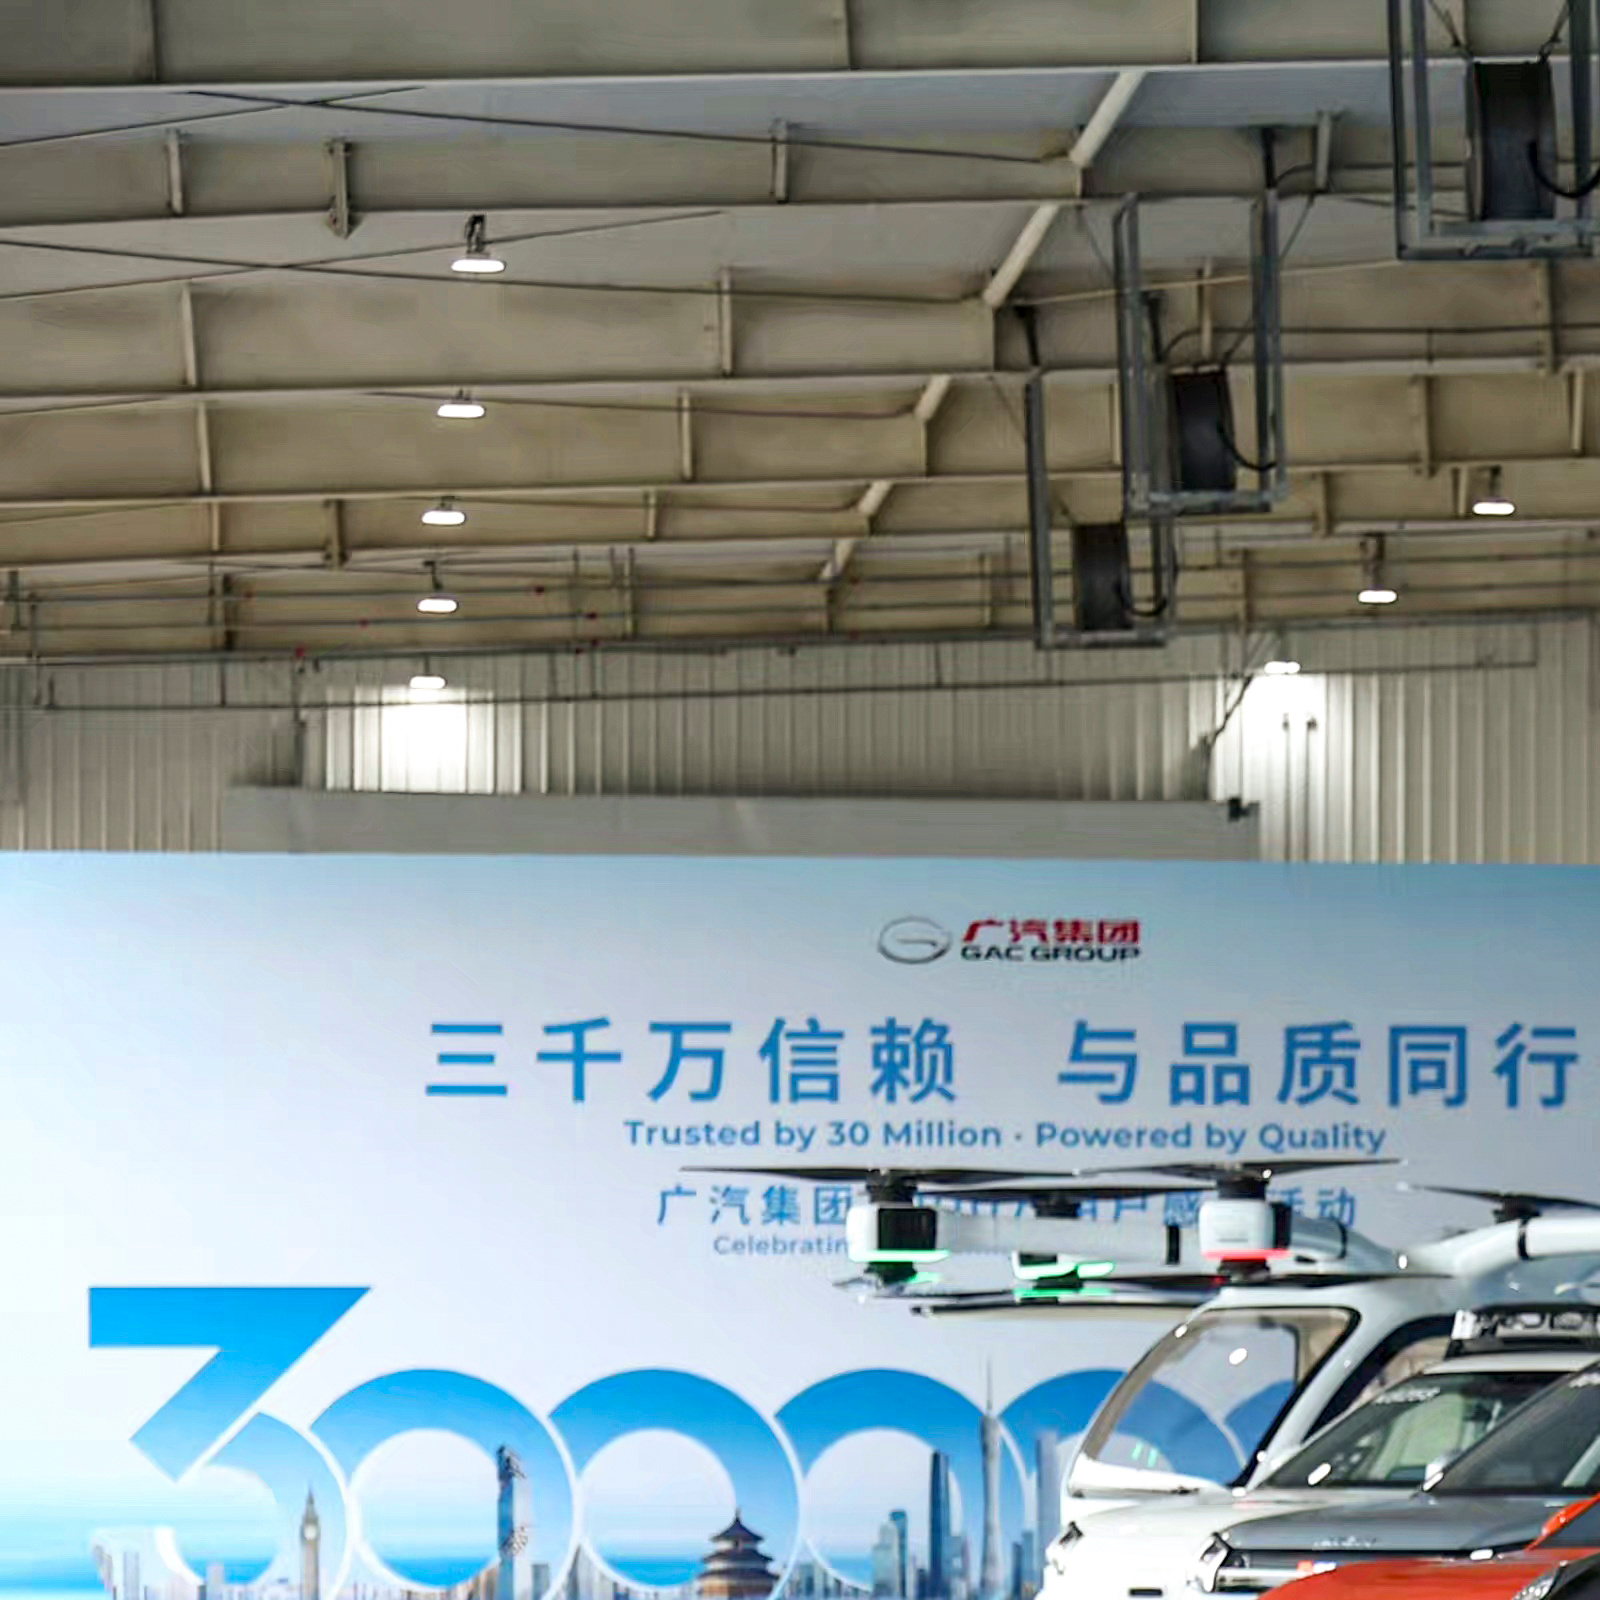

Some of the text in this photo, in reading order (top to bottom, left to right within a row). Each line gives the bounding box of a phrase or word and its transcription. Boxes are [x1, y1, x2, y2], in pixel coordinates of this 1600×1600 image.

[962, 918, 1141, 942] 广汽集团
[960, 945, 1141, 962] GAC GROUP
[425, 1016, 1580, 1110] 三千万信赖 与品质同行
[624, 1119, 1388, 1156] Trusted by 30 Million Powered by Quality
[712, 1234, 850, 1256] Celebratin
